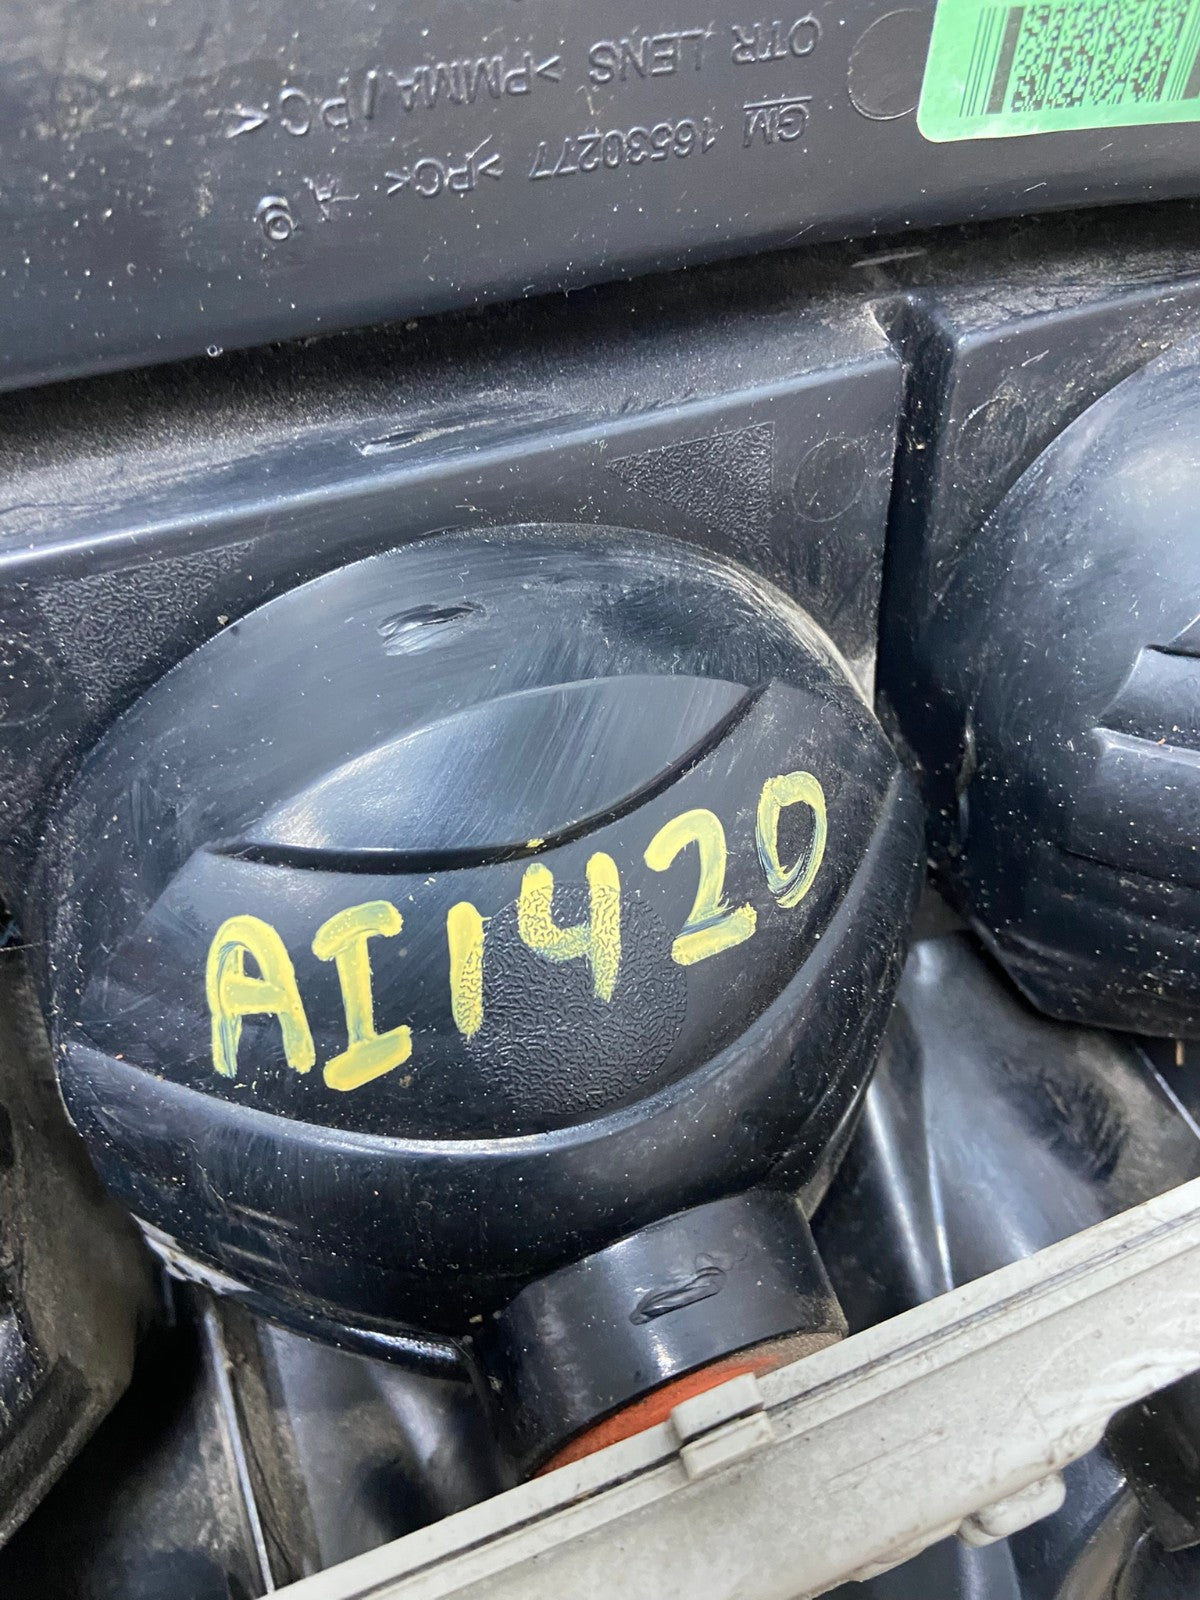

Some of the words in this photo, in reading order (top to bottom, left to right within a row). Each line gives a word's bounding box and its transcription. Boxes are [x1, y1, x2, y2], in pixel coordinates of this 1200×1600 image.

[588, 27, 706, 85] LENS
[731, 14, 822, 65] OTR
[528, 114, 723, 181] 16530277
[742, 95, 813, 149] GM
